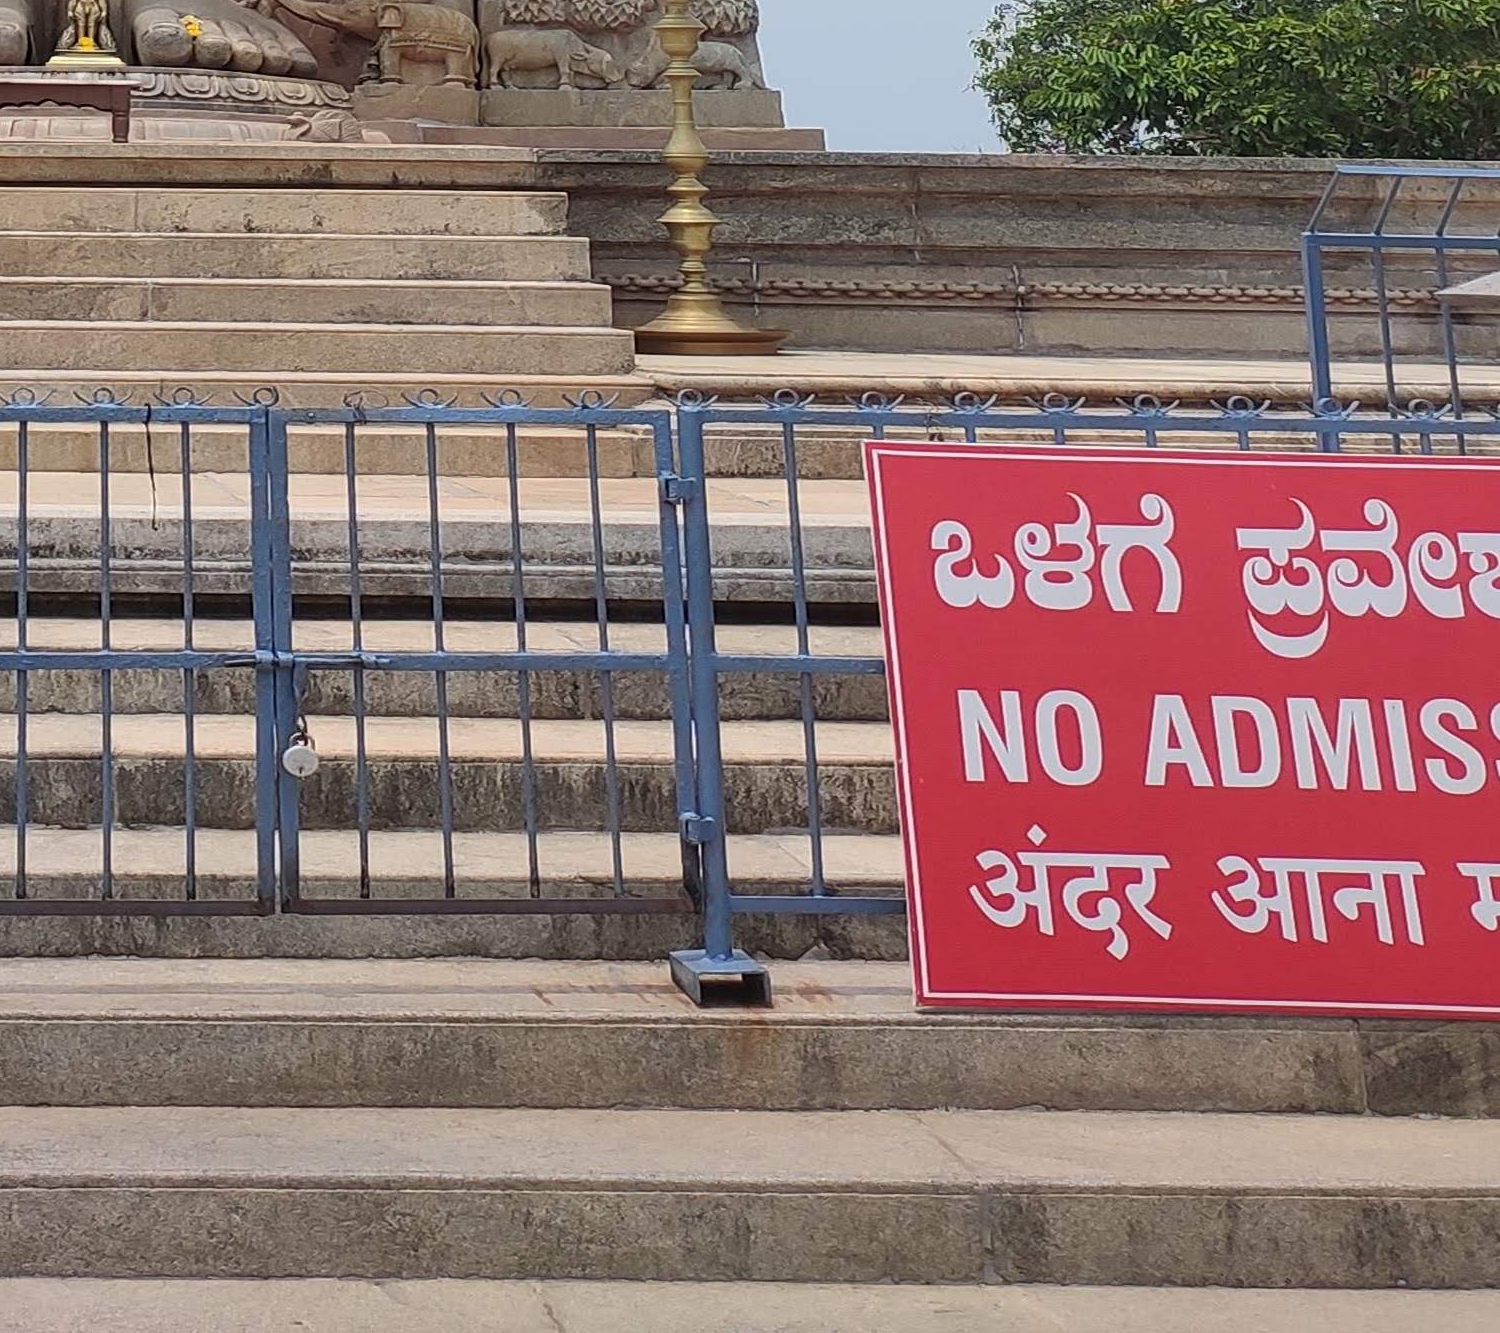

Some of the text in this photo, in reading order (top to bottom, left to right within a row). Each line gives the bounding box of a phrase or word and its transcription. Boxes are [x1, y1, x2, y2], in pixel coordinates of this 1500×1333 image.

[931, 491, 1183, 613] ಒಳಗೆ
[956, 688, 1500, 795] NO ADMIS
[968, 823, 1173, 961] अंदर
[1210, 854, 1427, 947] आना
